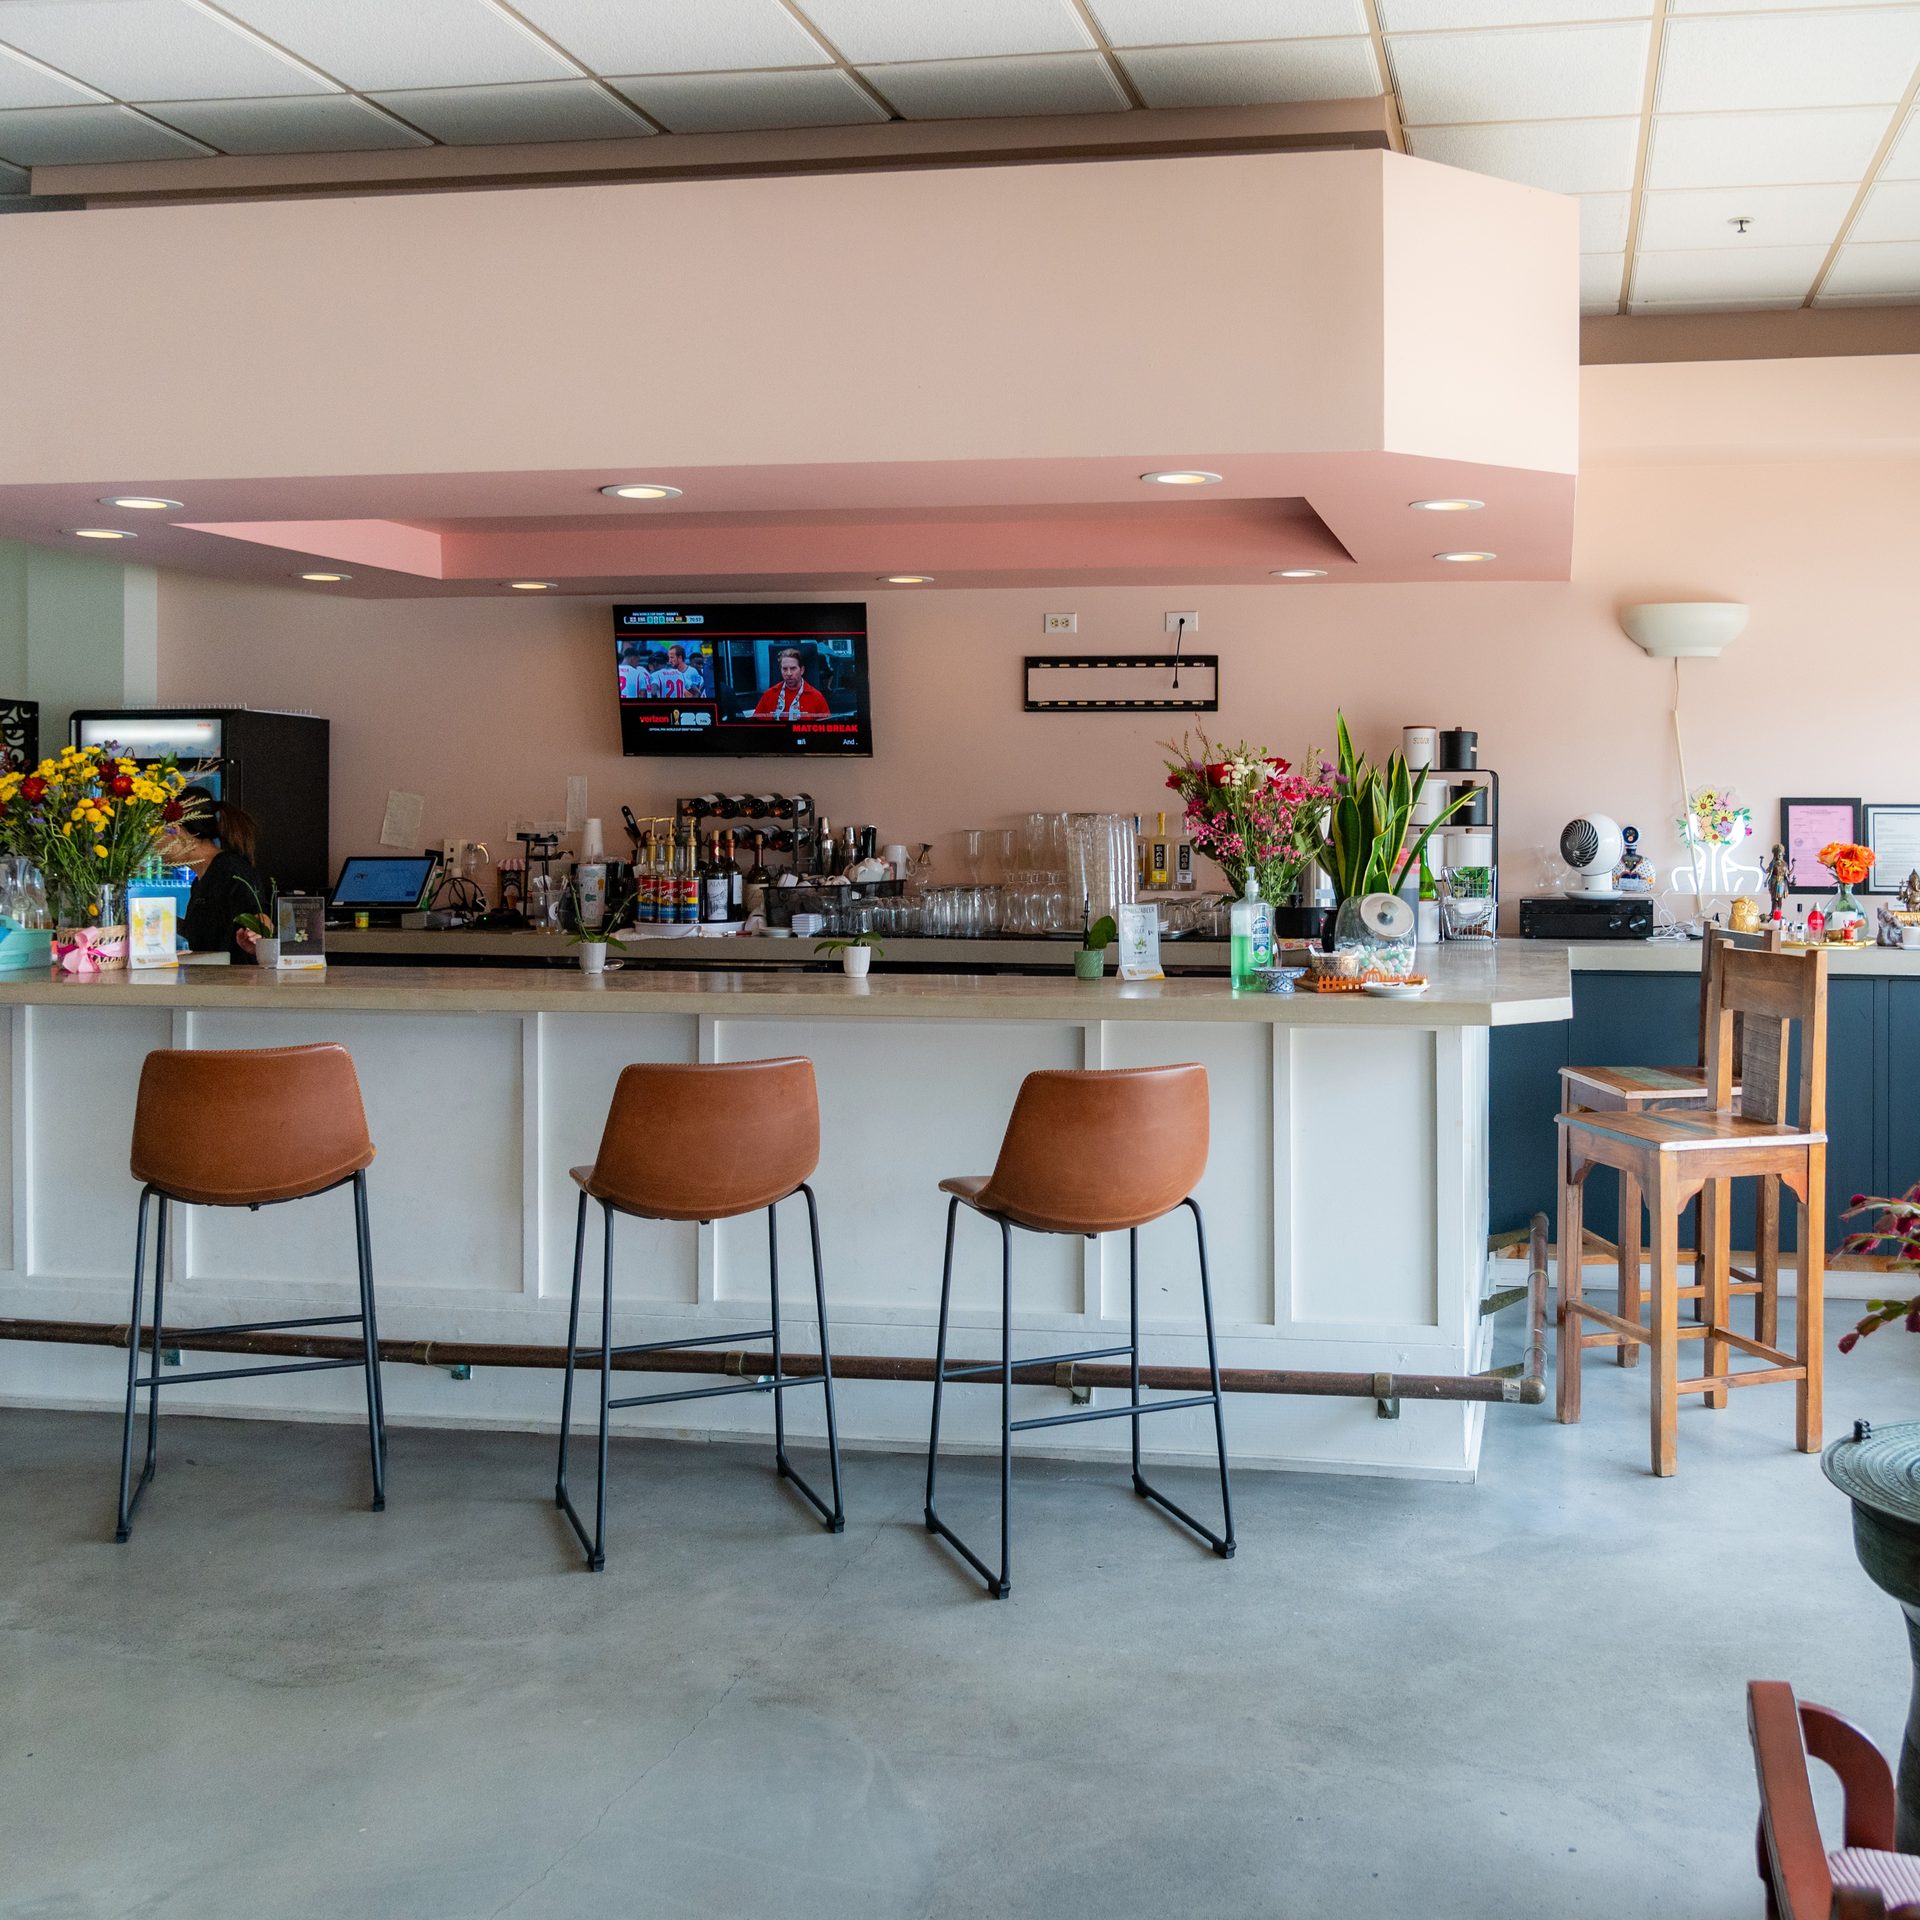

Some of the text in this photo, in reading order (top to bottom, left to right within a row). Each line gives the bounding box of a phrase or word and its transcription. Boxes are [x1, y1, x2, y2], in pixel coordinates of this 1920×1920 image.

[665, 678, 684, 698] 20
[639, 714, 669, 723] verizon
[792, 724, 858, 732] MATCH BREAK
[1413, 737, 1430, 745] SUGAR
